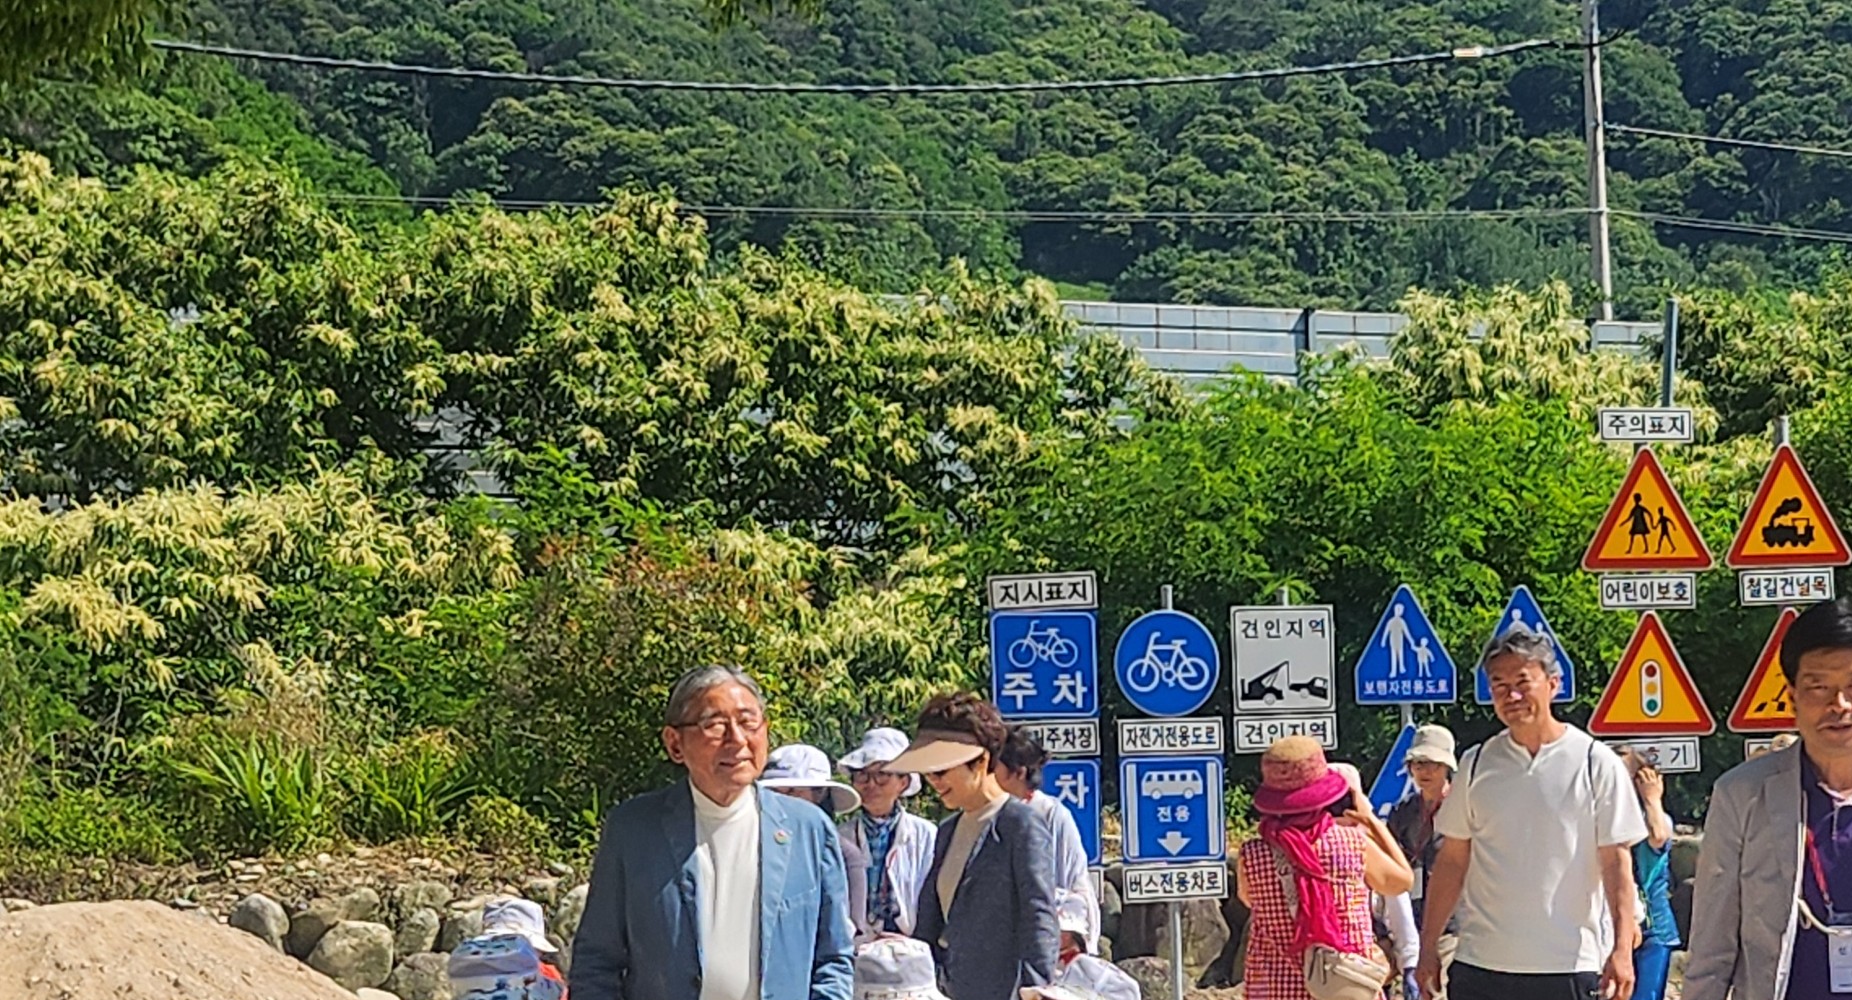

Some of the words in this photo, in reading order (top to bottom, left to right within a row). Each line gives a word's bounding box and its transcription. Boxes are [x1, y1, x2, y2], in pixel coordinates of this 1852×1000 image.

[1608, 414, 1685, 435] 주의표지
[999, 579, 1087, 605] 지시표지
[1605, 581, 1689, 601] 어린이보호
[1746, 575, 1826, 598] 철길건널목
[1241, 618, 1325, 639] 견인지역
[1364, 679, 1449, 696] 보행자전용도로
[1126, 725, 1217, 748] 자전거전용도로
[1157, 805, 1190, 822] 전용
[1129, 870, 1221, 895] 버스전용차로
